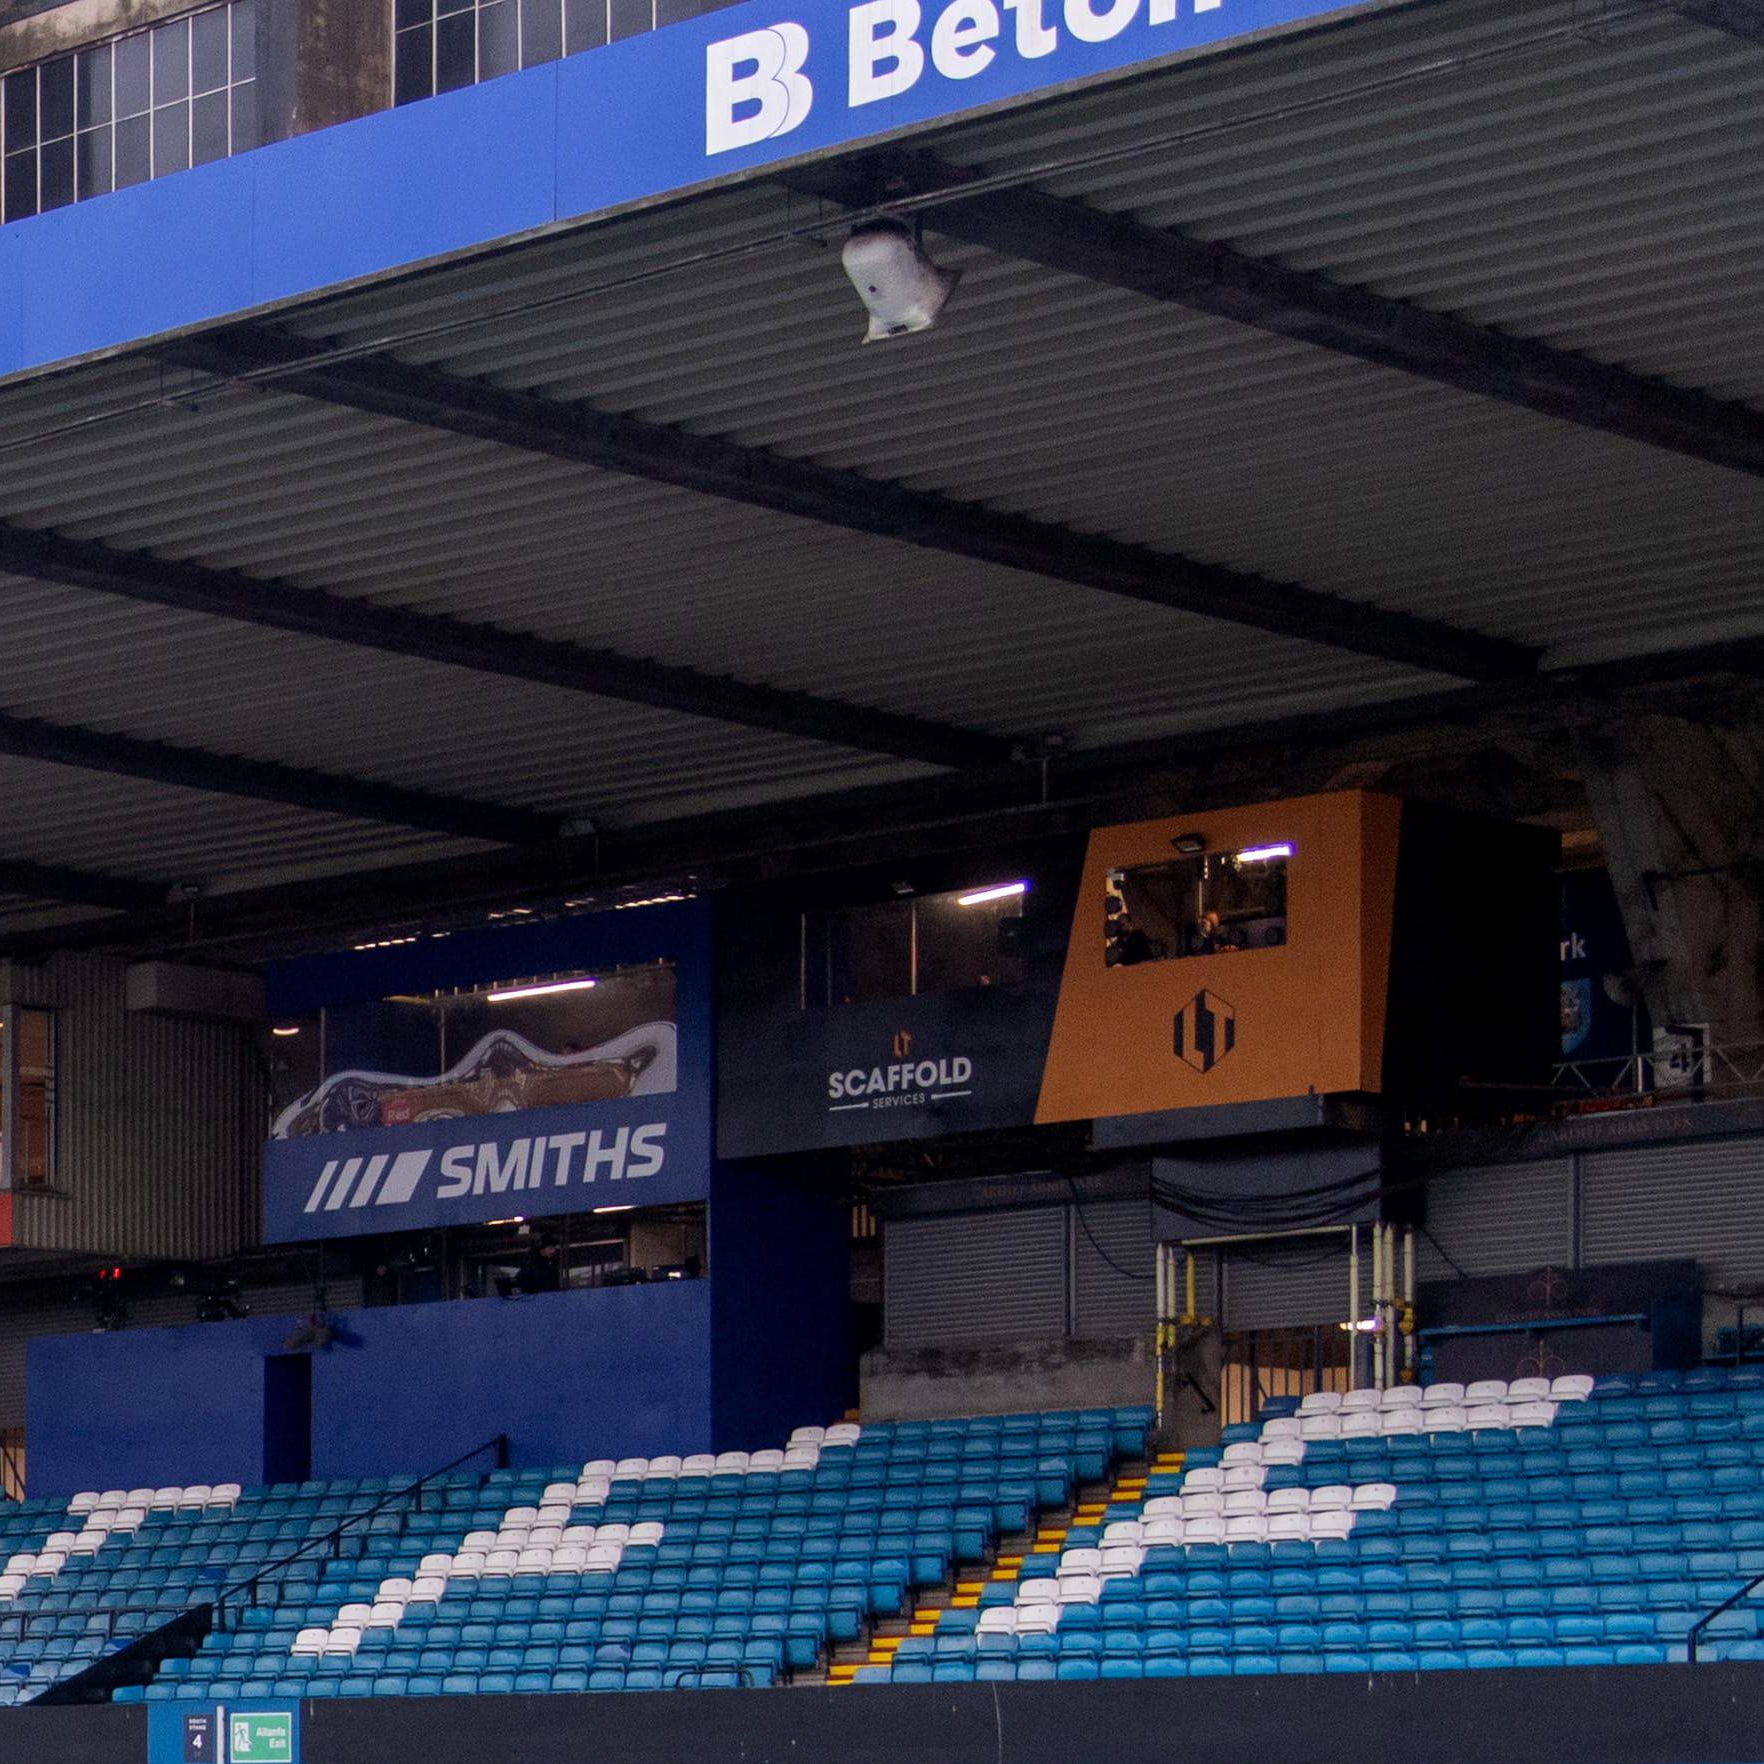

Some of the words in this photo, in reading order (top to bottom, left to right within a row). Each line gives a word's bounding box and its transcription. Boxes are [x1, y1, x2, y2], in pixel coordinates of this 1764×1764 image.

[828, 1056, 972, 1099] SCAFFOLD
[872, 1092, 926, 1110] SERVICES
[436, 1122, 667, 1200] SMITHS
[192, 1734, 202, 1749] 4
